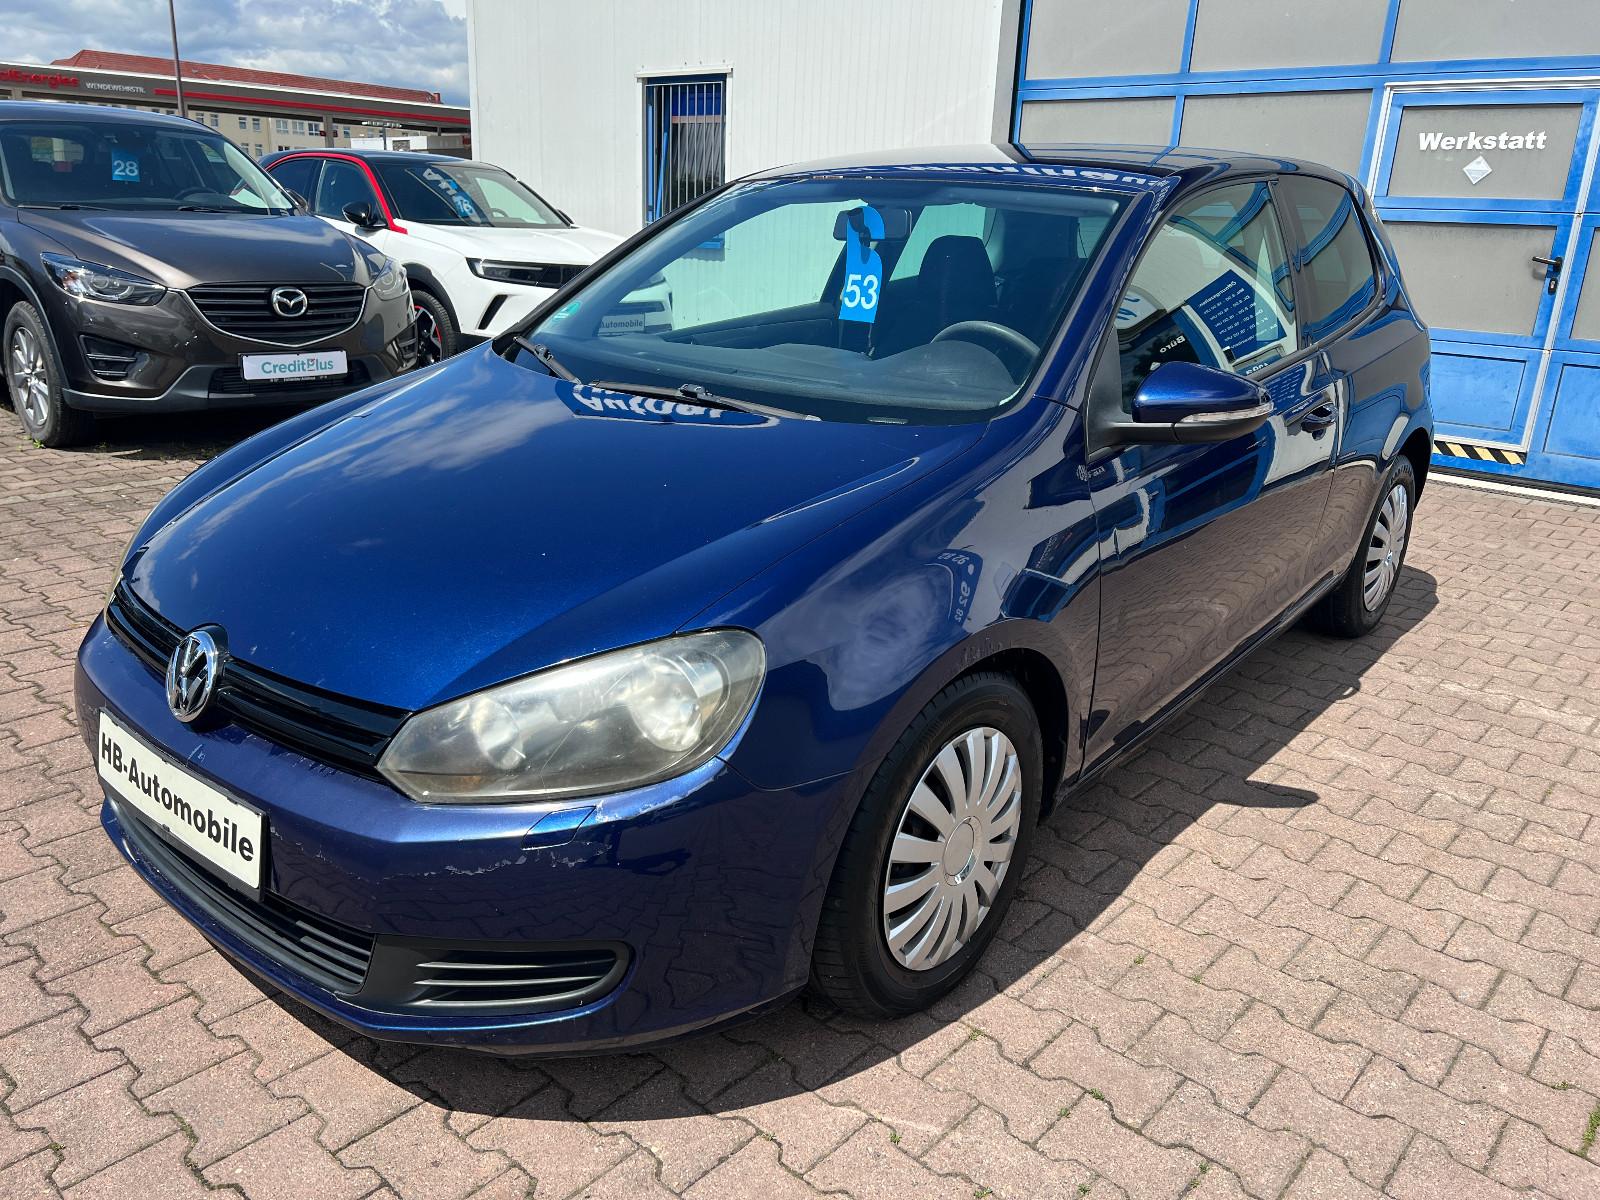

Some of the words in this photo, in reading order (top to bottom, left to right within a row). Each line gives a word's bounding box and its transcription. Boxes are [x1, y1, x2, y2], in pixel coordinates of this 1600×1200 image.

[1418, 130, 1547, 150] Werkstatt
[113, 159, 139, 177] 28
[844, 273, 879, 310] 53
[261, 358, 334, 374] CreditPlus
[101, 732, 255, 862] HB-Automobile
